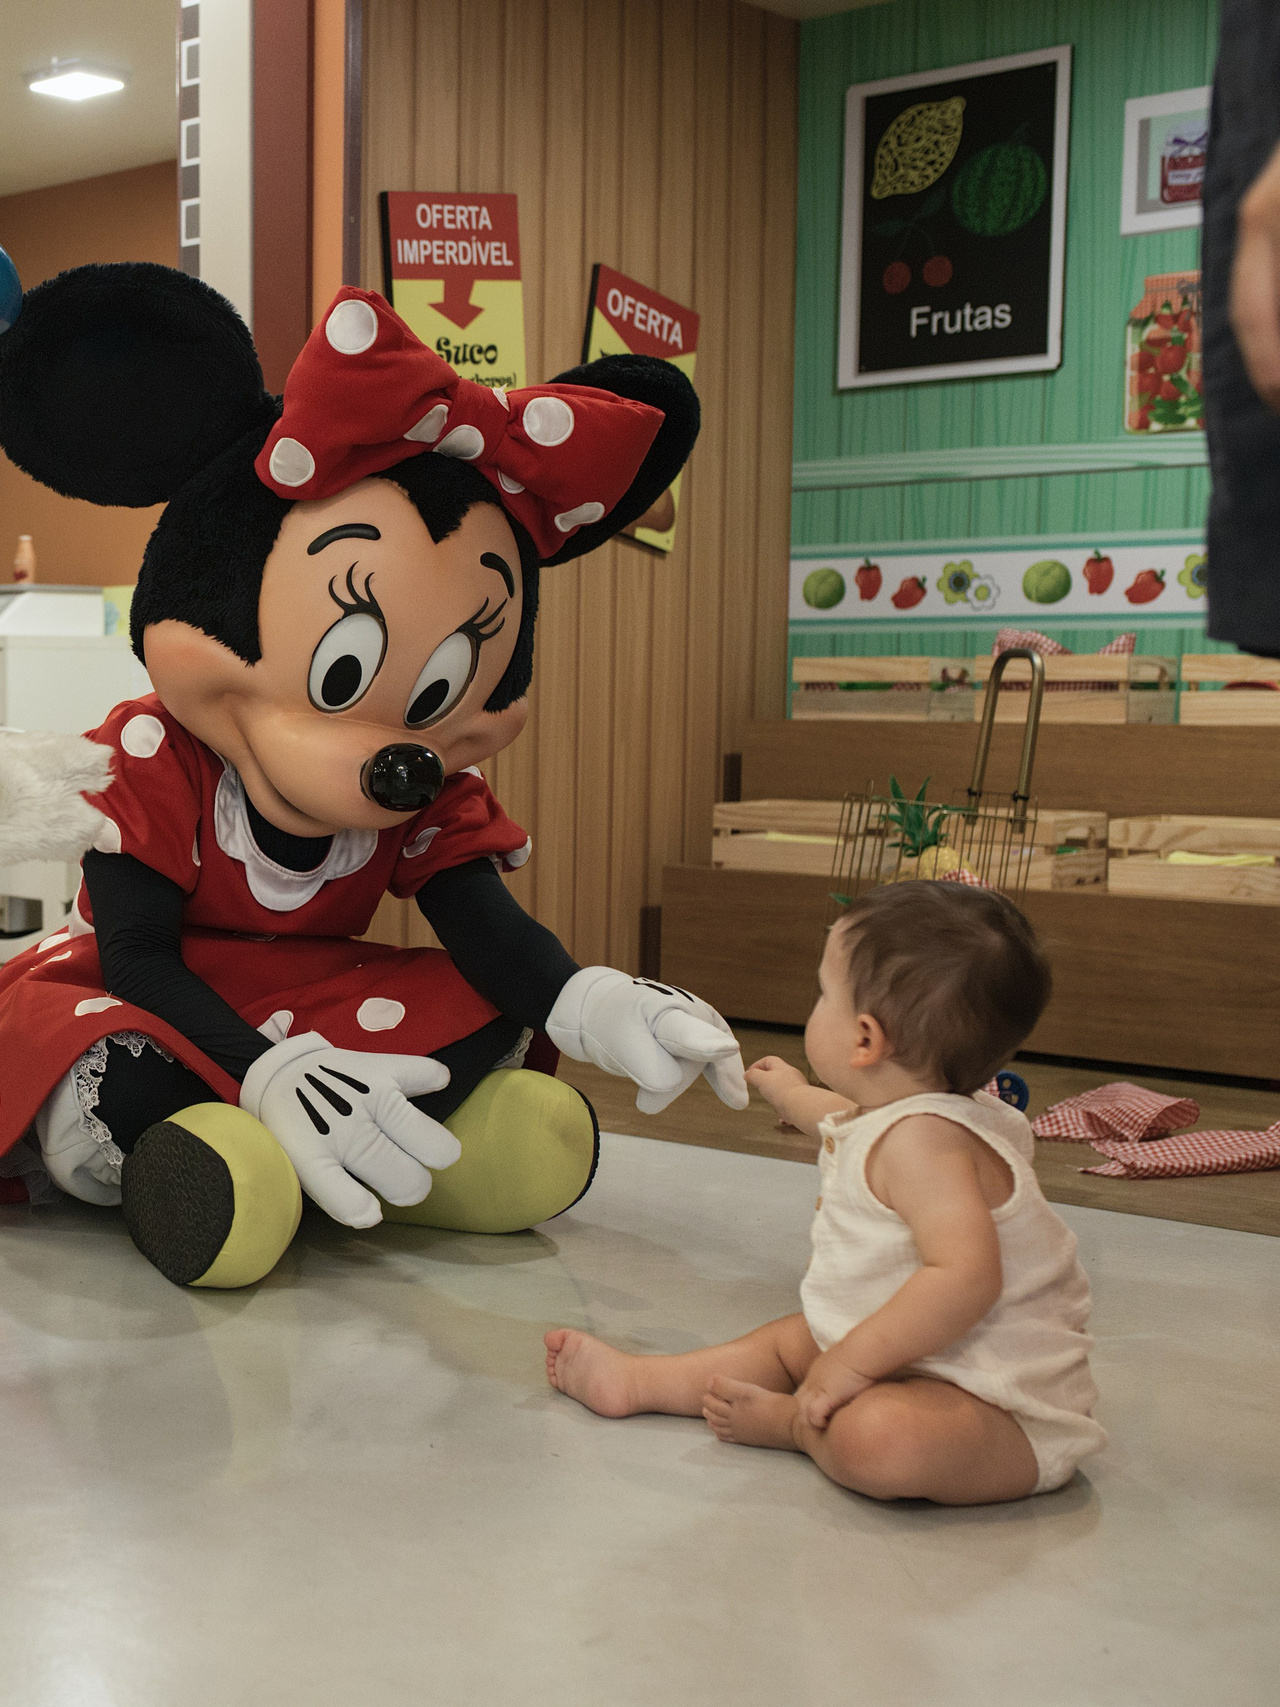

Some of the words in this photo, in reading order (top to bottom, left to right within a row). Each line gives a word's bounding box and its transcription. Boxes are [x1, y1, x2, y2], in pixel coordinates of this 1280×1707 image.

[415, 203, 493, 231] OFERTA
[396, 235, 514, 267] IMPERDÍVEL
[607, 289, 684, 350] OFERTA
[910, 302, 1013, 338] Frutas
[436, 336, 498, 365] Suco
